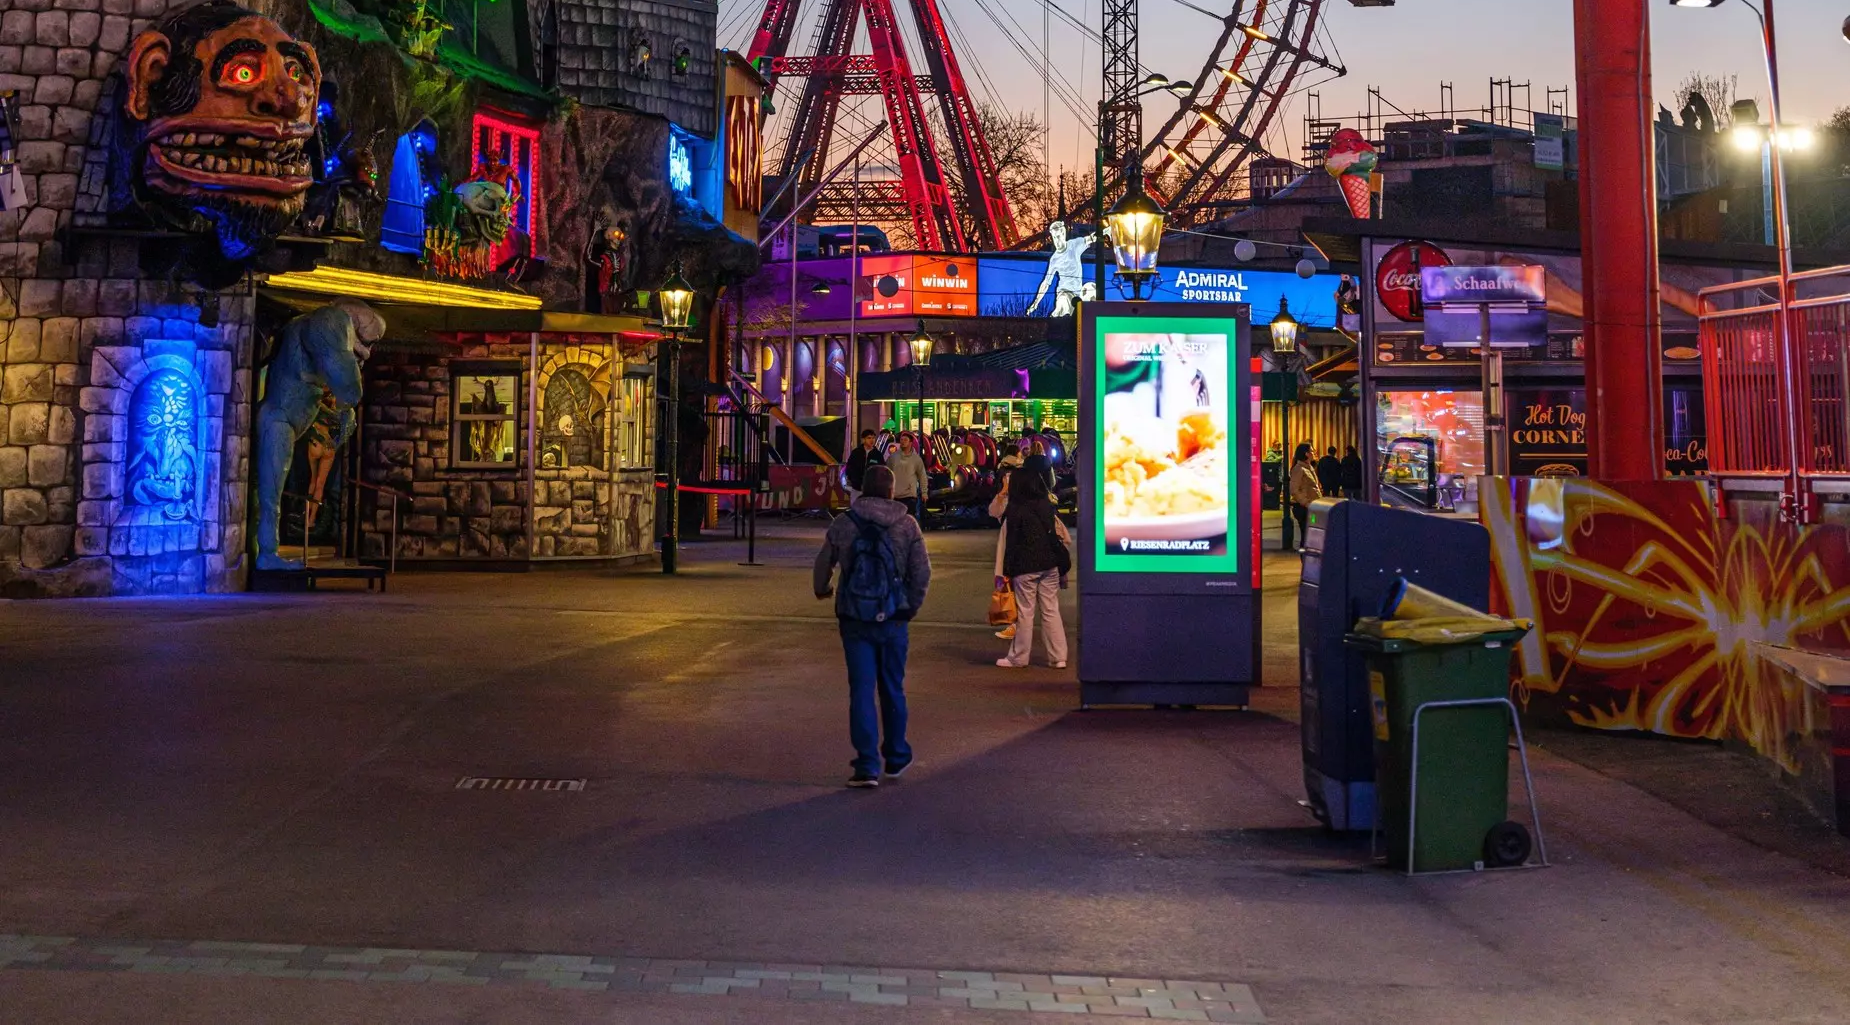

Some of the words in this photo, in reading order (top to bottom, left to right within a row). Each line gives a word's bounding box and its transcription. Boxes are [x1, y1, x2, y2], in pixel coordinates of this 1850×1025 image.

[1175, 270, 1248, 290] ADMIRAL
[1182, 289, 1242, 302] SPORTSBAR
[1123, 342, 1155, 354] ZUM
[892, 379, 992, 395] REISANDENKEN
[1525, 404, 1554, 426] Hot
[1556, 404, 1586, 431] Dog
[1513, 429, 1585, 444] CORNE
[1130, 539, 1210, 550] RIESENRADPLATZ
